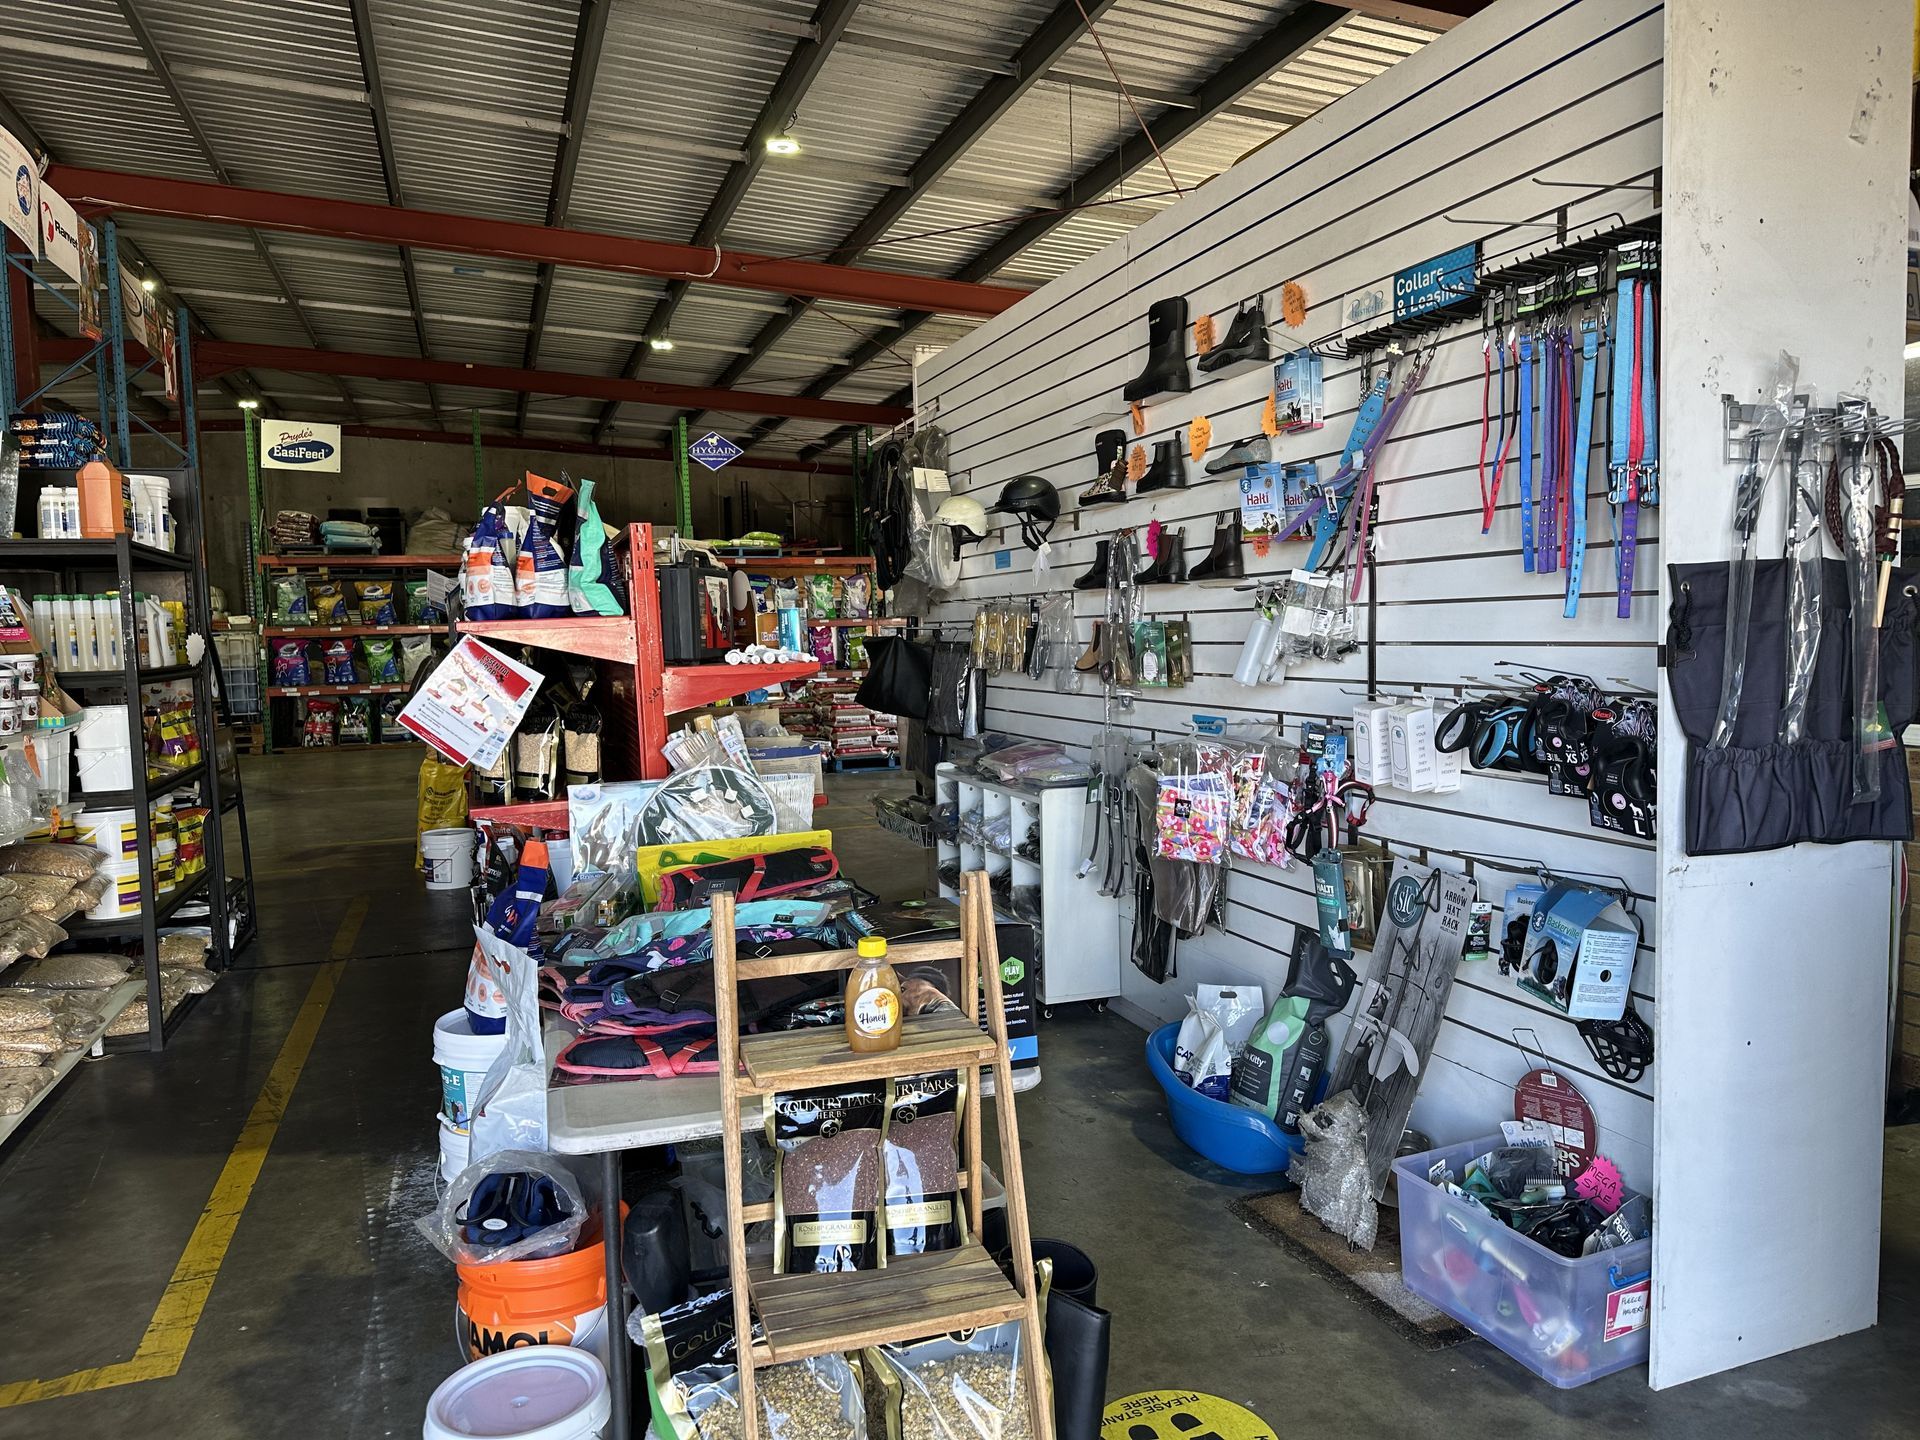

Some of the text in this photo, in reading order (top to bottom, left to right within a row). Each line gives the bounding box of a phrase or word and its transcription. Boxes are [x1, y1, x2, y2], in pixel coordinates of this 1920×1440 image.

[1396, 267, 1444, 296] Collars
[1396, 282, 1465, 317] & Leashes
[279, 427, 314, 443] Pryde's
[273, 446, 325, 460] EasiFeed
[692, 446, 736, 455] HYGAIN
[1246, 491, 1269, 506] Halti
[1284, 491, 1304, 506] Halti
[1565, 752, 1578, 764] XS
[1444, 890, 1468, 908] ARROW
[1447, 903, 1461, 918] HAT
[1441, 916, 1460, 931] RACK
[1547, 916, 1581, 940] Baskerville
[1004, 966, 1020, 976] PLAY
[859, 1013, 887, 1024] Honey
[920, 1079, 956, 1094] PARK
[775, 1092, 885, 1116] COUNTRY PARK
[816, 1110, 847, 1121] HERBS
[1587, 1165, 1618, 1194] MEGA
[1581, 1177, 1612, 1206] SALE
[1621, 1295, 1643, 1306] FLEECE
[672, 1315, 734, 1360] COUN
[1120, 1394, 1161, 1411] HERE
[1148, 1393, 1200, 1415] PLEASE
